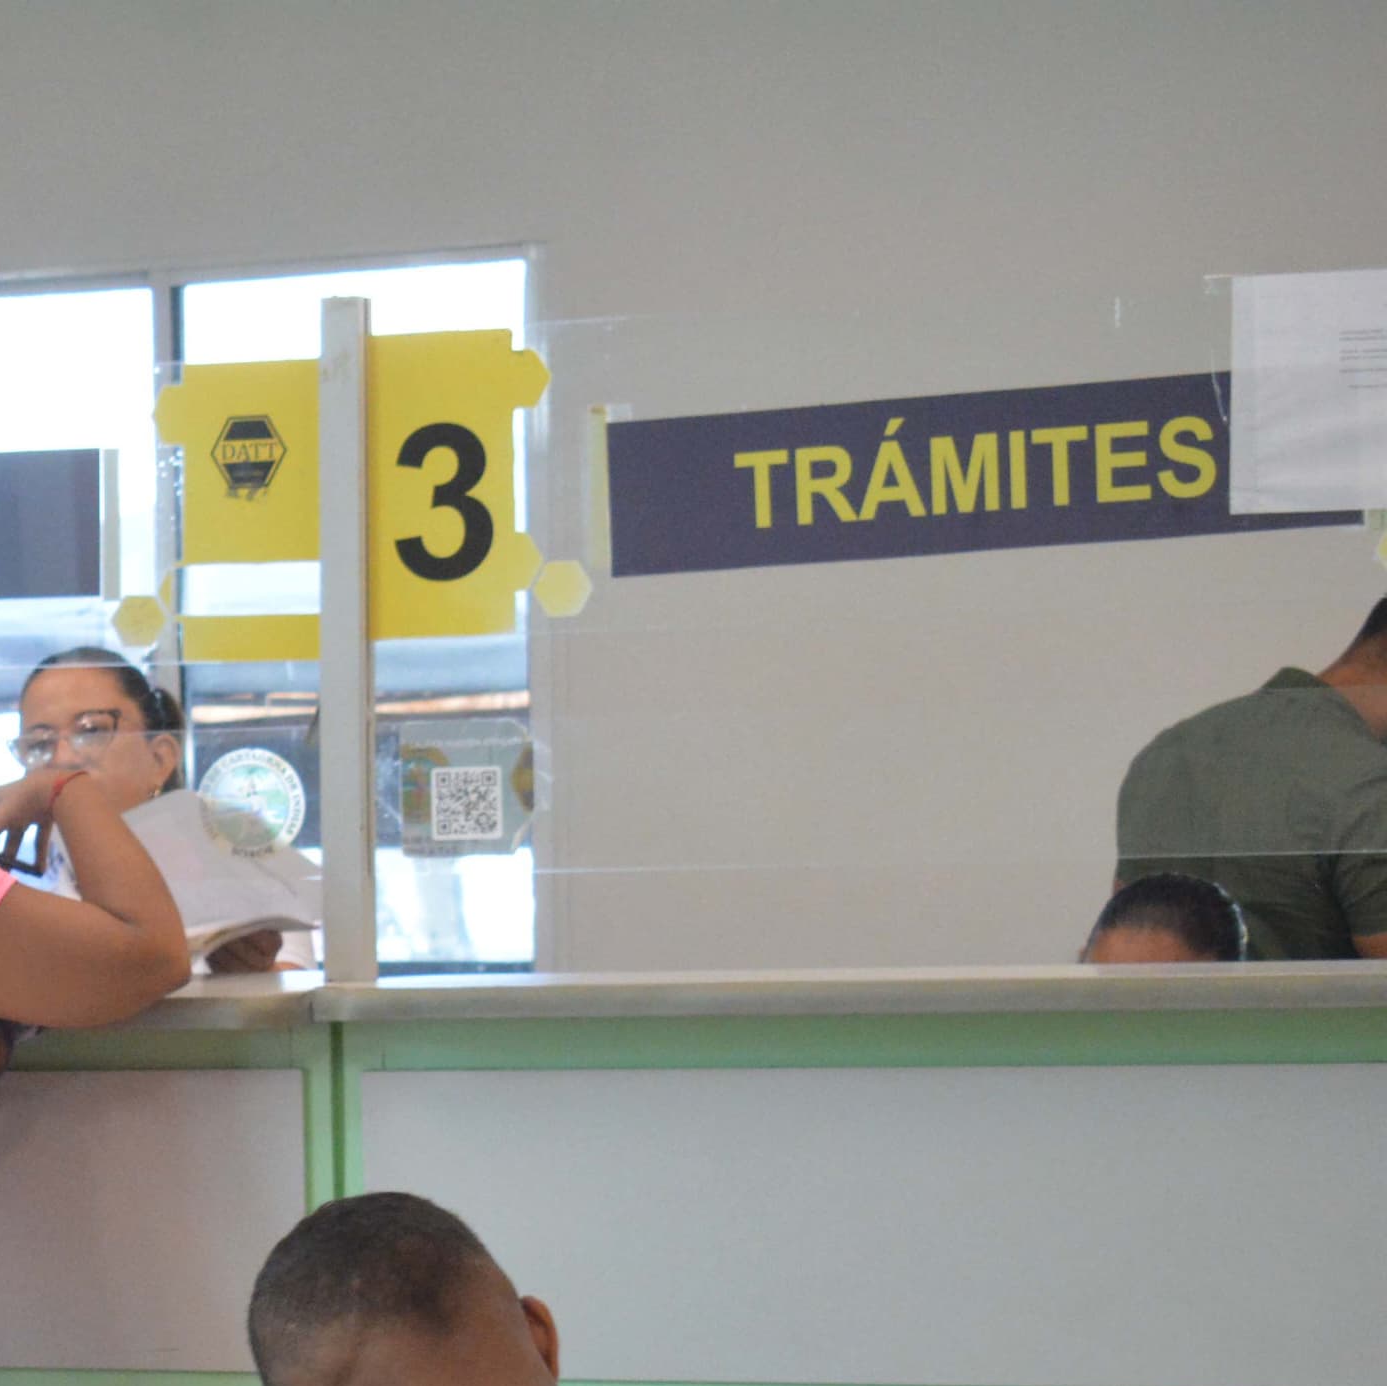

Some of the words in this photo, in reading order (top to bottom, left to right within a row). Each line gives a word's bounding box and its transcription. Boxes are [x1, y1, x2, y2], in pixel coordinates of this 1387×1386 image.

[221, 441, 277, 462] DATT
[396, 423, 493, 581] 3
[734, 416, 1219, 529] TRÁMITES
